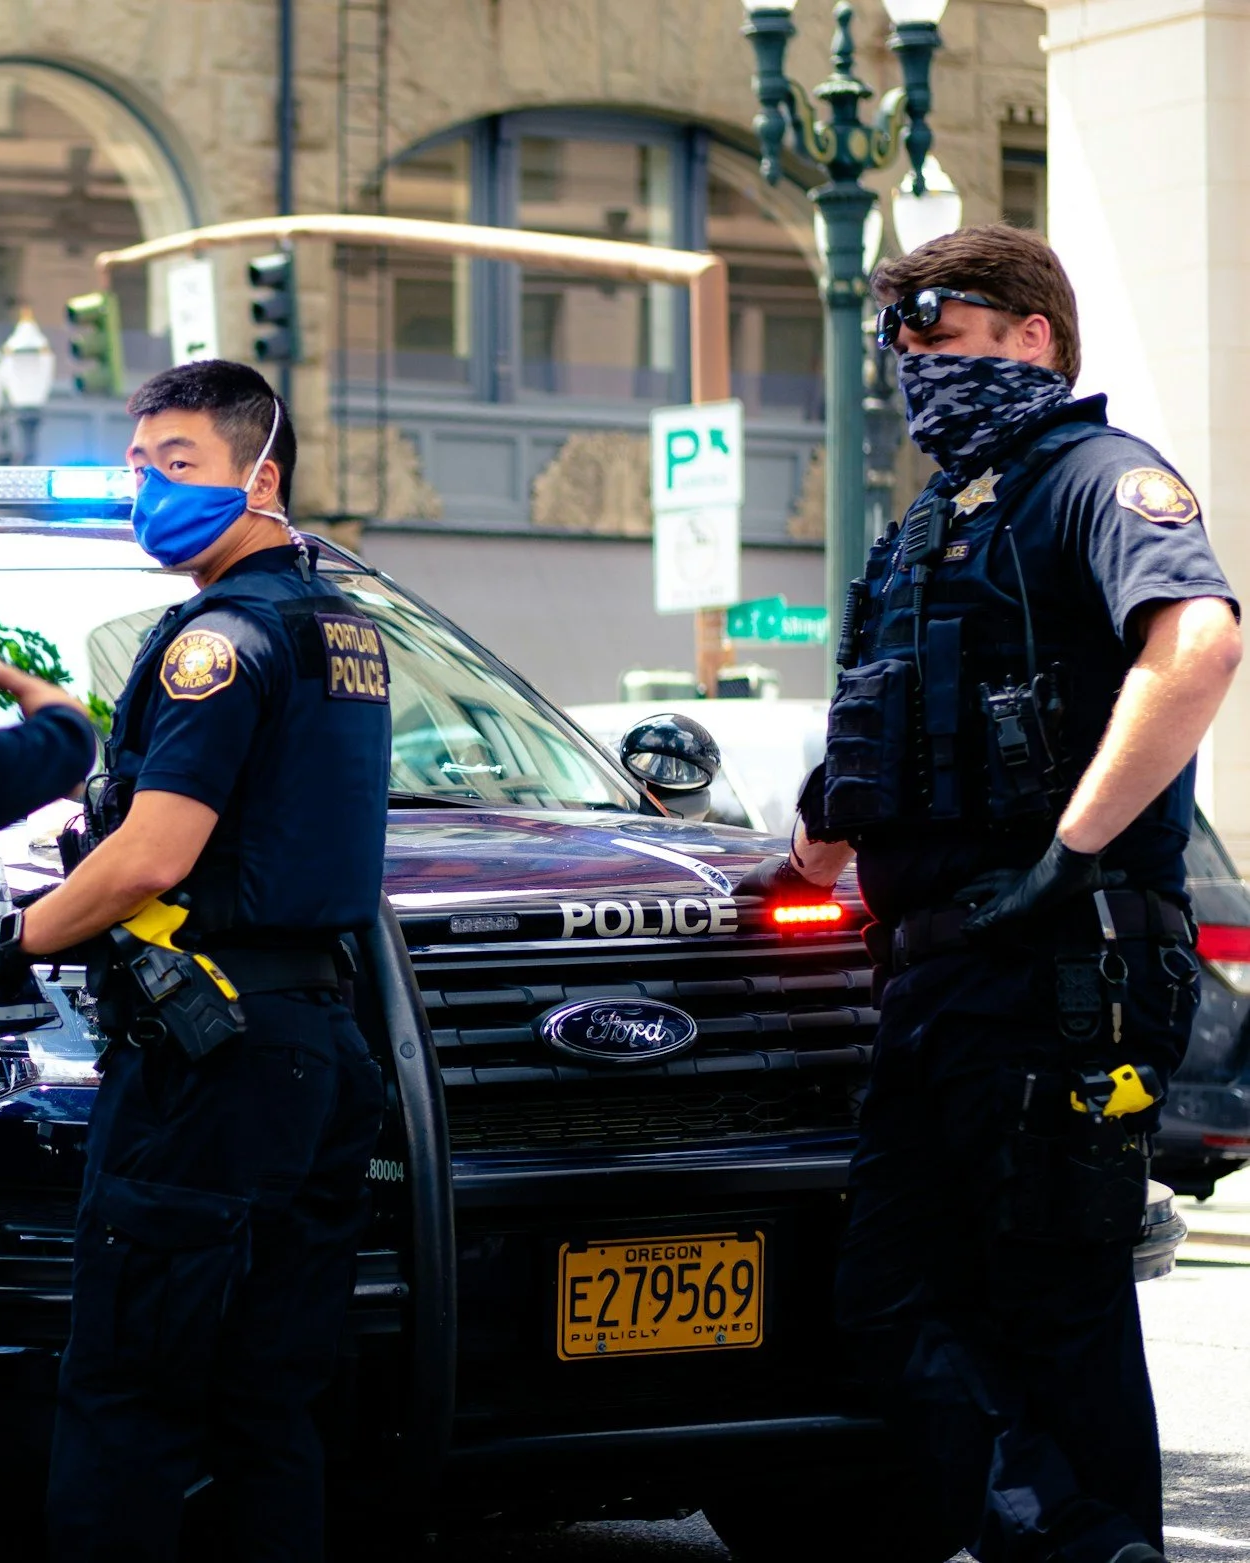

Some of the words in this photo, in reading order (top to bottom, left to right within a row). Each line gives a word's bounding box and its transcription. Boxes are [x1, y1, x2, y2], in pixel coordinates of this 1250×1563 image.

[667, 430, 699, 489] P
[323, 622, 379, 655] PORTLAND
[331, 656, 386, 696] POLICE
[559, 897, 739, 938] POLICE
[587, 1007, 666, 1043] Ford
[625, 1245, 702, 1262] OREGON
[569, 1260, 754, 1328] E279569
[570, 1328, 660, 1342] PUBLICLY
[693, 1322, 754, 1334] OWNED
